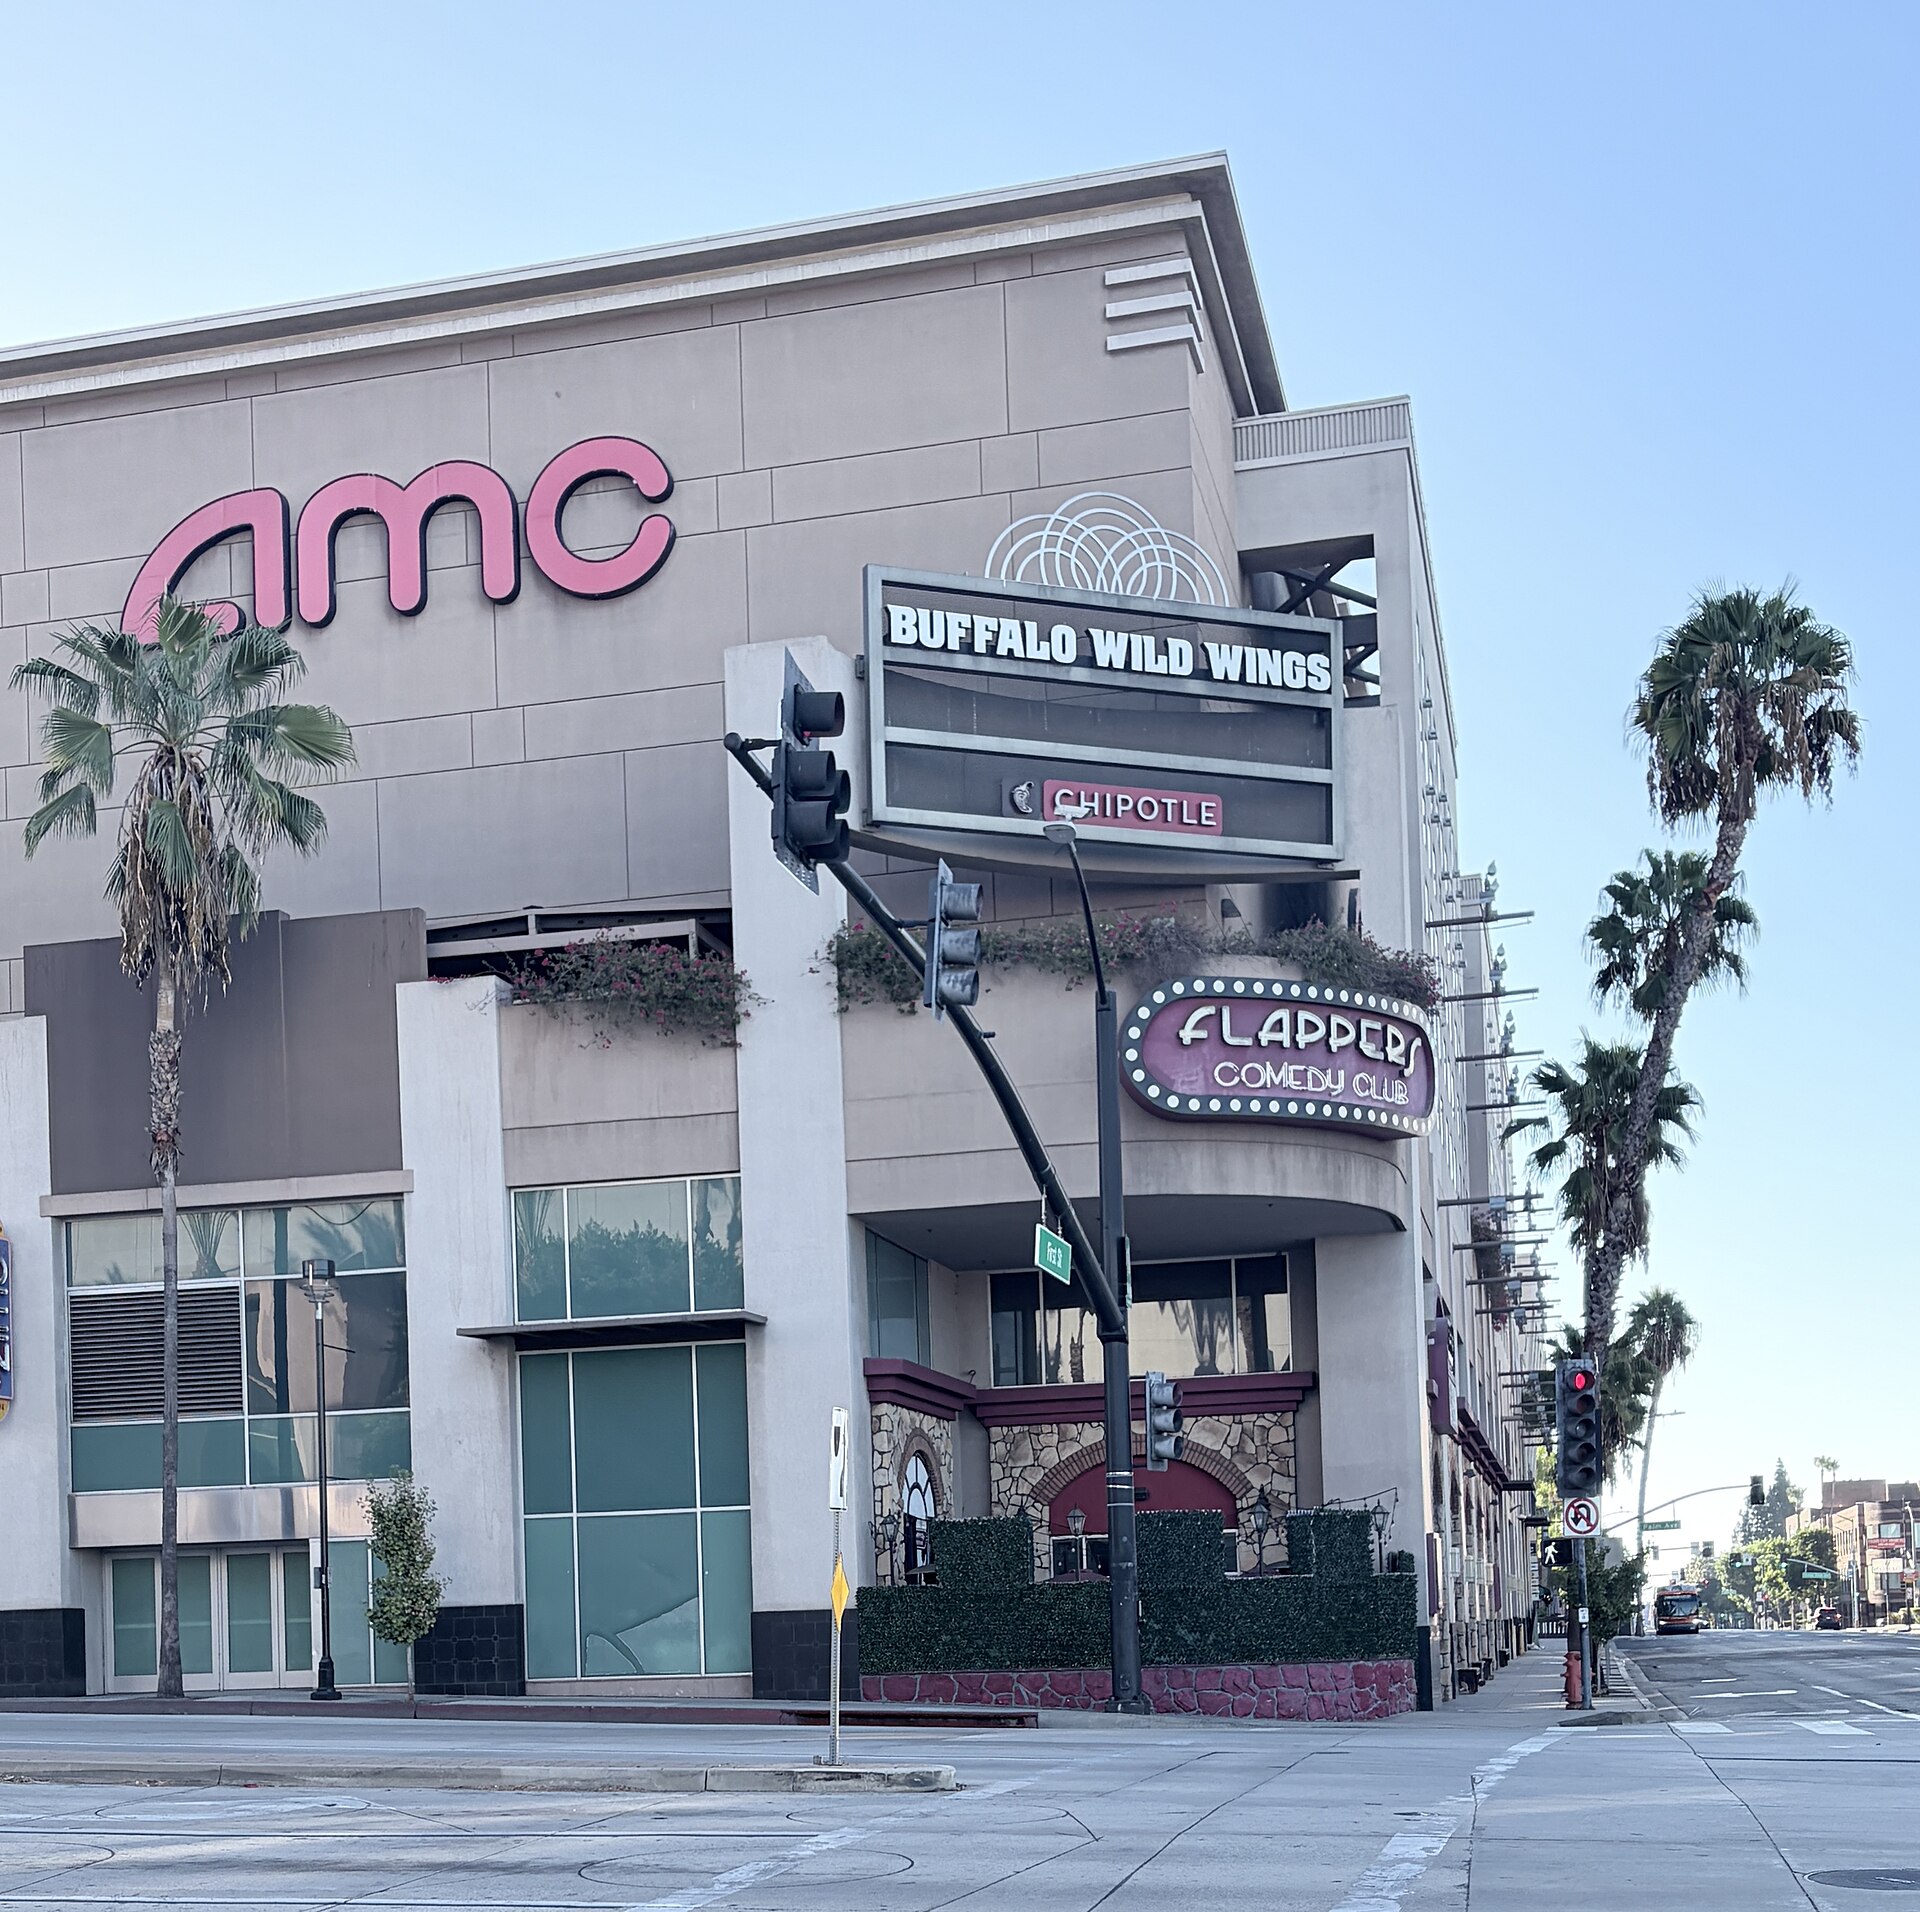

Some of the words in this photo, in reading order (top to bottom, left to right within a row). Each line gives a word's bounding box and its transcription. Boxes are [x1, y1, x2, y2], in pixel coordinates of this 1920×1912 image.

[886, 604, 1077, 665] BUFFALO
[1087, 628, 1194, 676] WILD
[1202, 641, 1332, 692] WINGS
[1053, 788, 1217, 828] CHIPOTLE
[1178, 1004, 1422, 1077] FLAPPERS
[1214, 1061, 1345, 1096] COMEDY
[1352, 1072, 1409, 1105] CLUB
